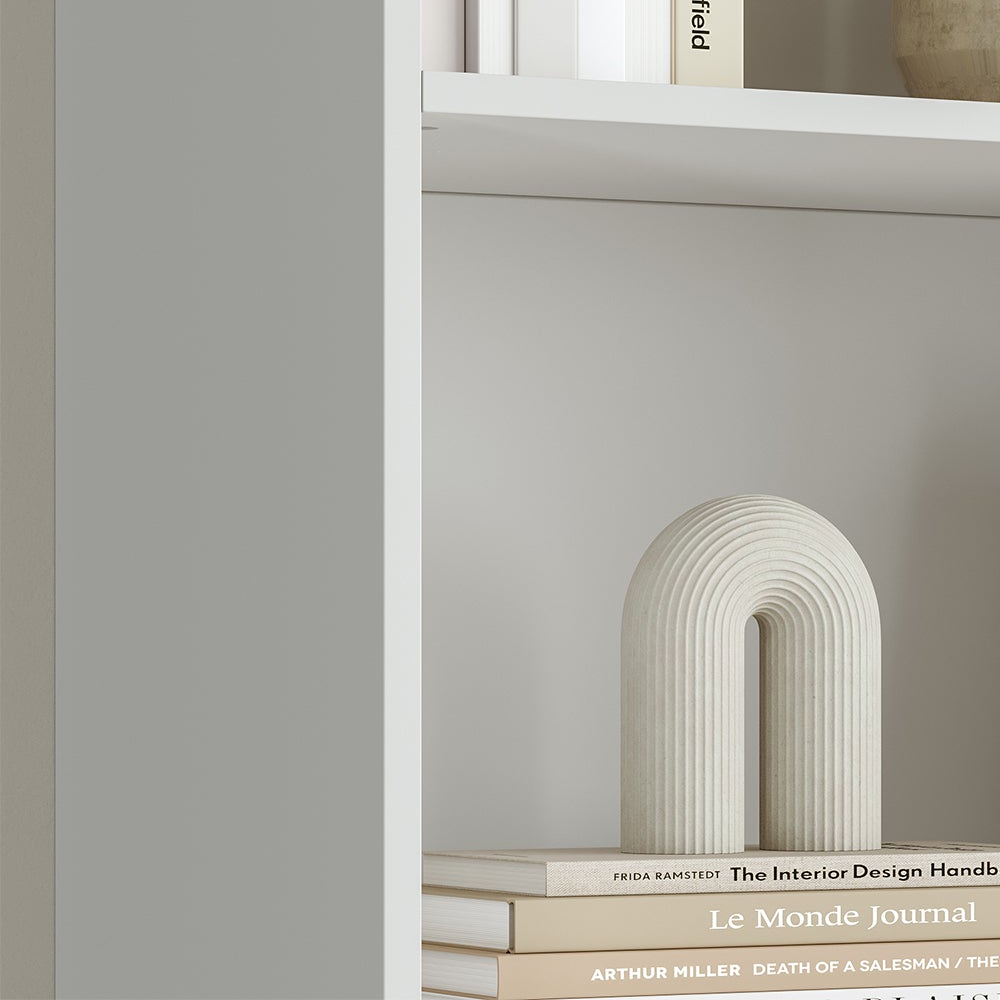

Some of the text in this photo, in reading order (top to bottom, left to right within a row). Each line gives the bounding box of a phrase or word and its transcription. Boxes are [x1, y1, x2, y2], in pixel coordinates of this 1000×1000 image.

[656, 870, 721, 880] RAMSTEDT
[730, 867, 766, 881] The
[774, 867, 848, 880] Interior
[854, 865, 922, 881] Design
[710, 902, 976, 929] Le Monde Journal
[591, 965, 740, 980] ARTHUR MILLER
[754, 962, 810, 975] DEATH
[816, 961, 837, 973] OF
[844, 961, 855, 972] A
[860, 958, 949, 971] SALESMAN
[967, 956, 999, 967] THE
